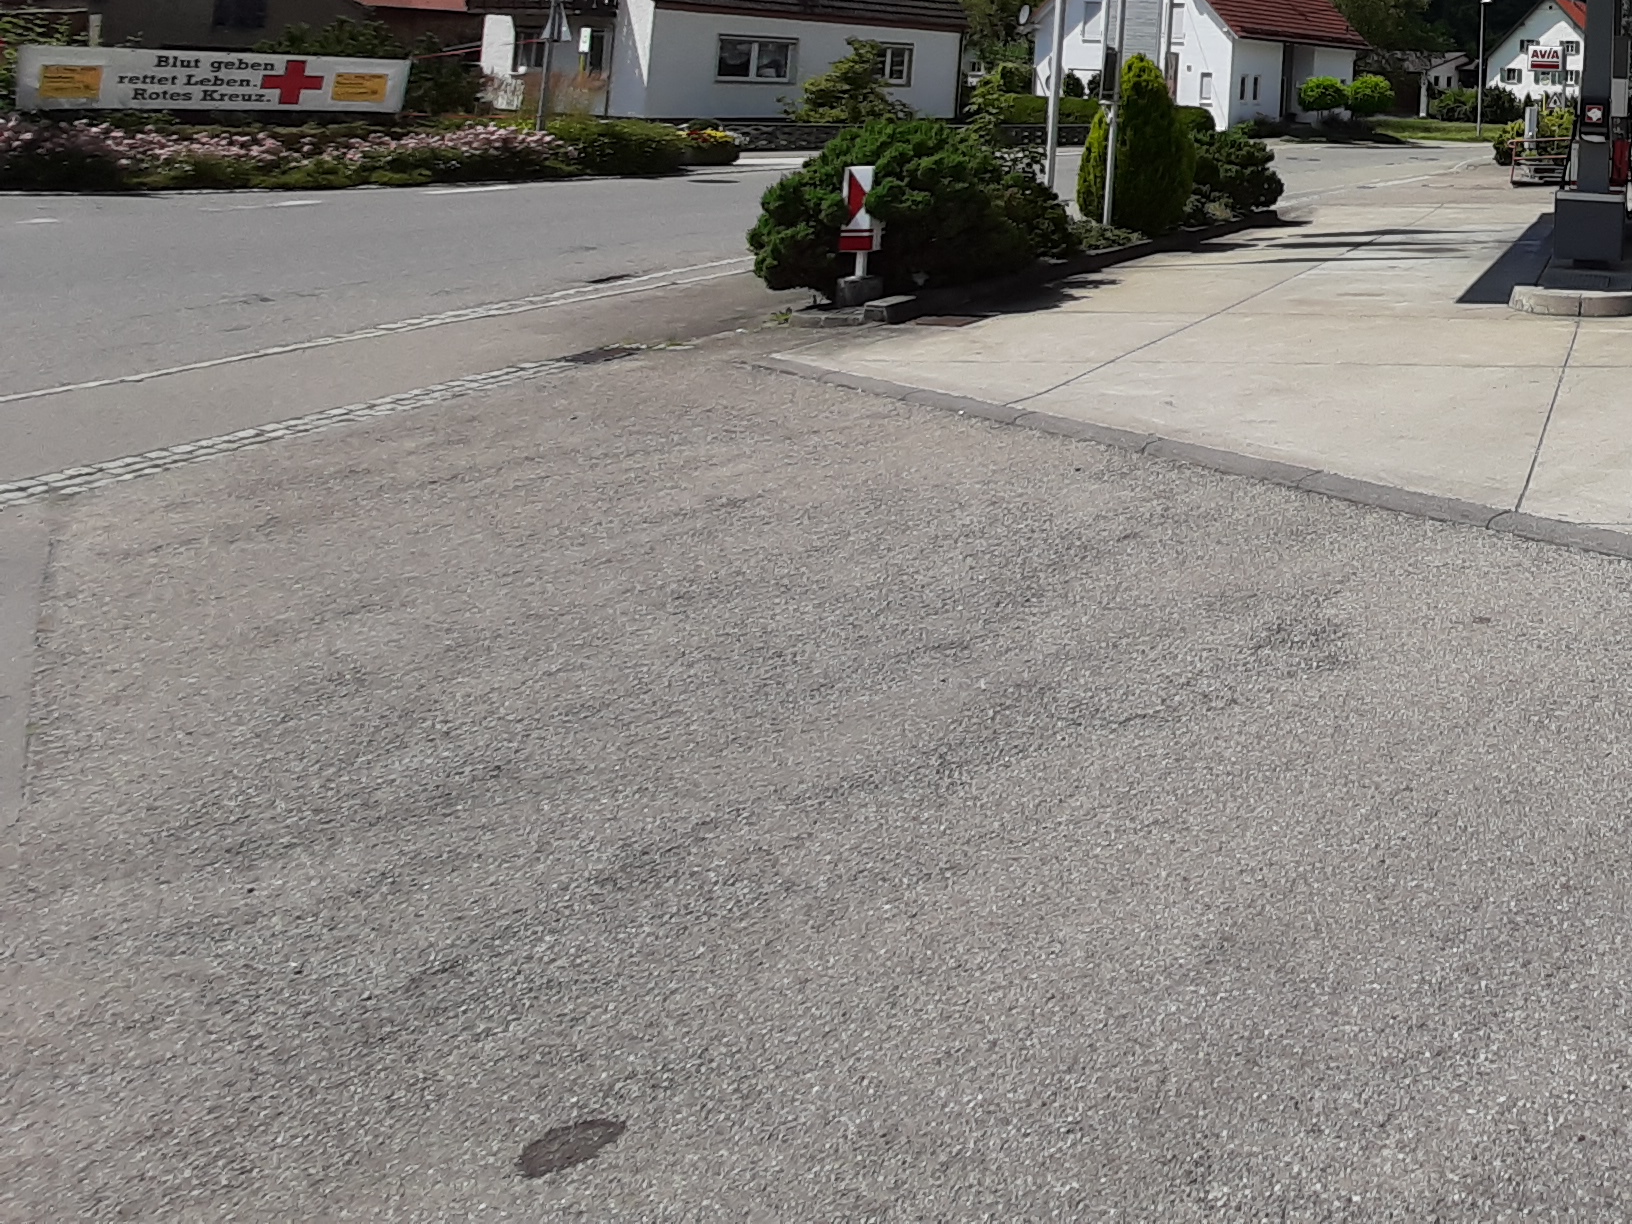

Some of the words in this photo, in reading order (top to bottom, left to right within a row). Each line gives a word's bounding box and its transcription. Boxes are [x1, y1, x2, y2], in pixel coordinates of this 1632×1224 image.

[154, 55, 201, 69] Blut
[210, 58, 275, 73] geben
[117, 74, 178, 86] rettet
[183, 74, 258, 88] Leben.
[131, 88, 193, 101] Rotes
[200, 89, 271, 103] Kreuz.
